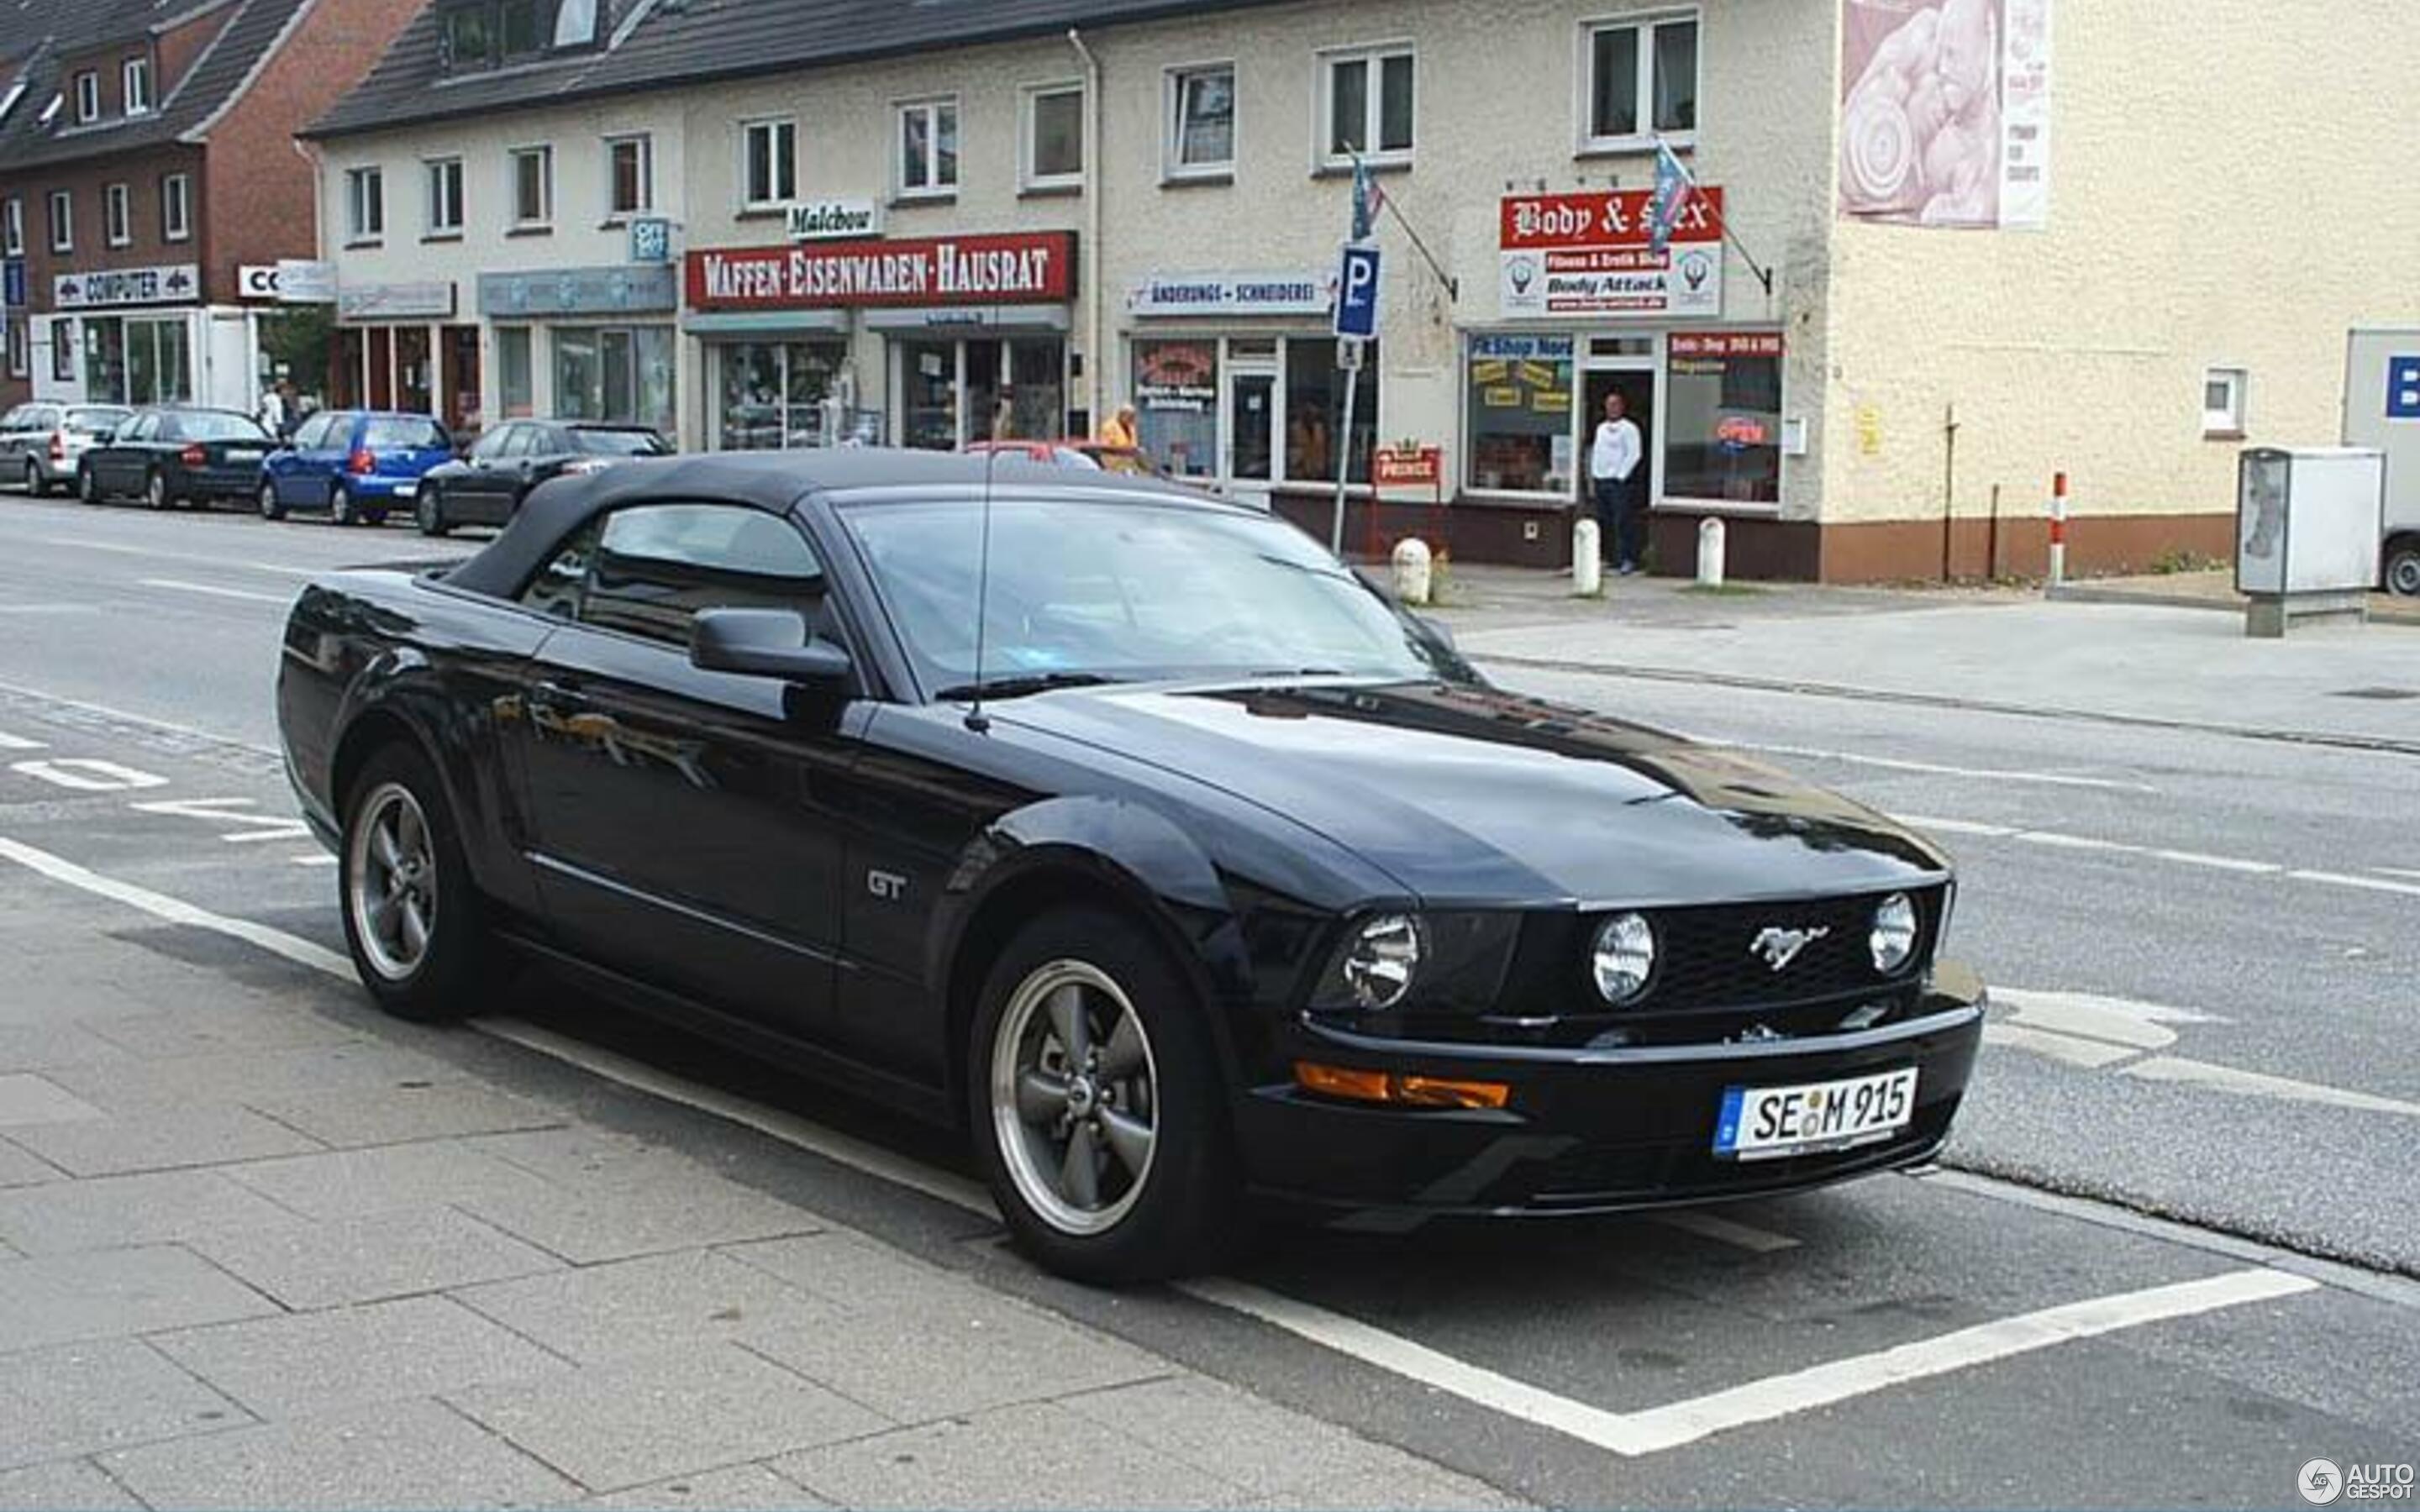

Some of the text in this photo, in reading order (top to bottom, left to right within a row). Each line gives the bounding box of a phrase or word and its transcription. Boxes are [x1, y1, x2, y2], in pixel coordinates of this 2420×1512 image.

[1513, 201, 1592, 241] Body
[1602, 196, 1628, 233] &
[86, 270, 159, 302] COMPUTER
[1345, 256, 1371, 306] P
[1547, 274, 1668, 295] Body Attack
[868, 870, 907, 899] GT
[1754, 1075, 1908, 1140] SE M 915
